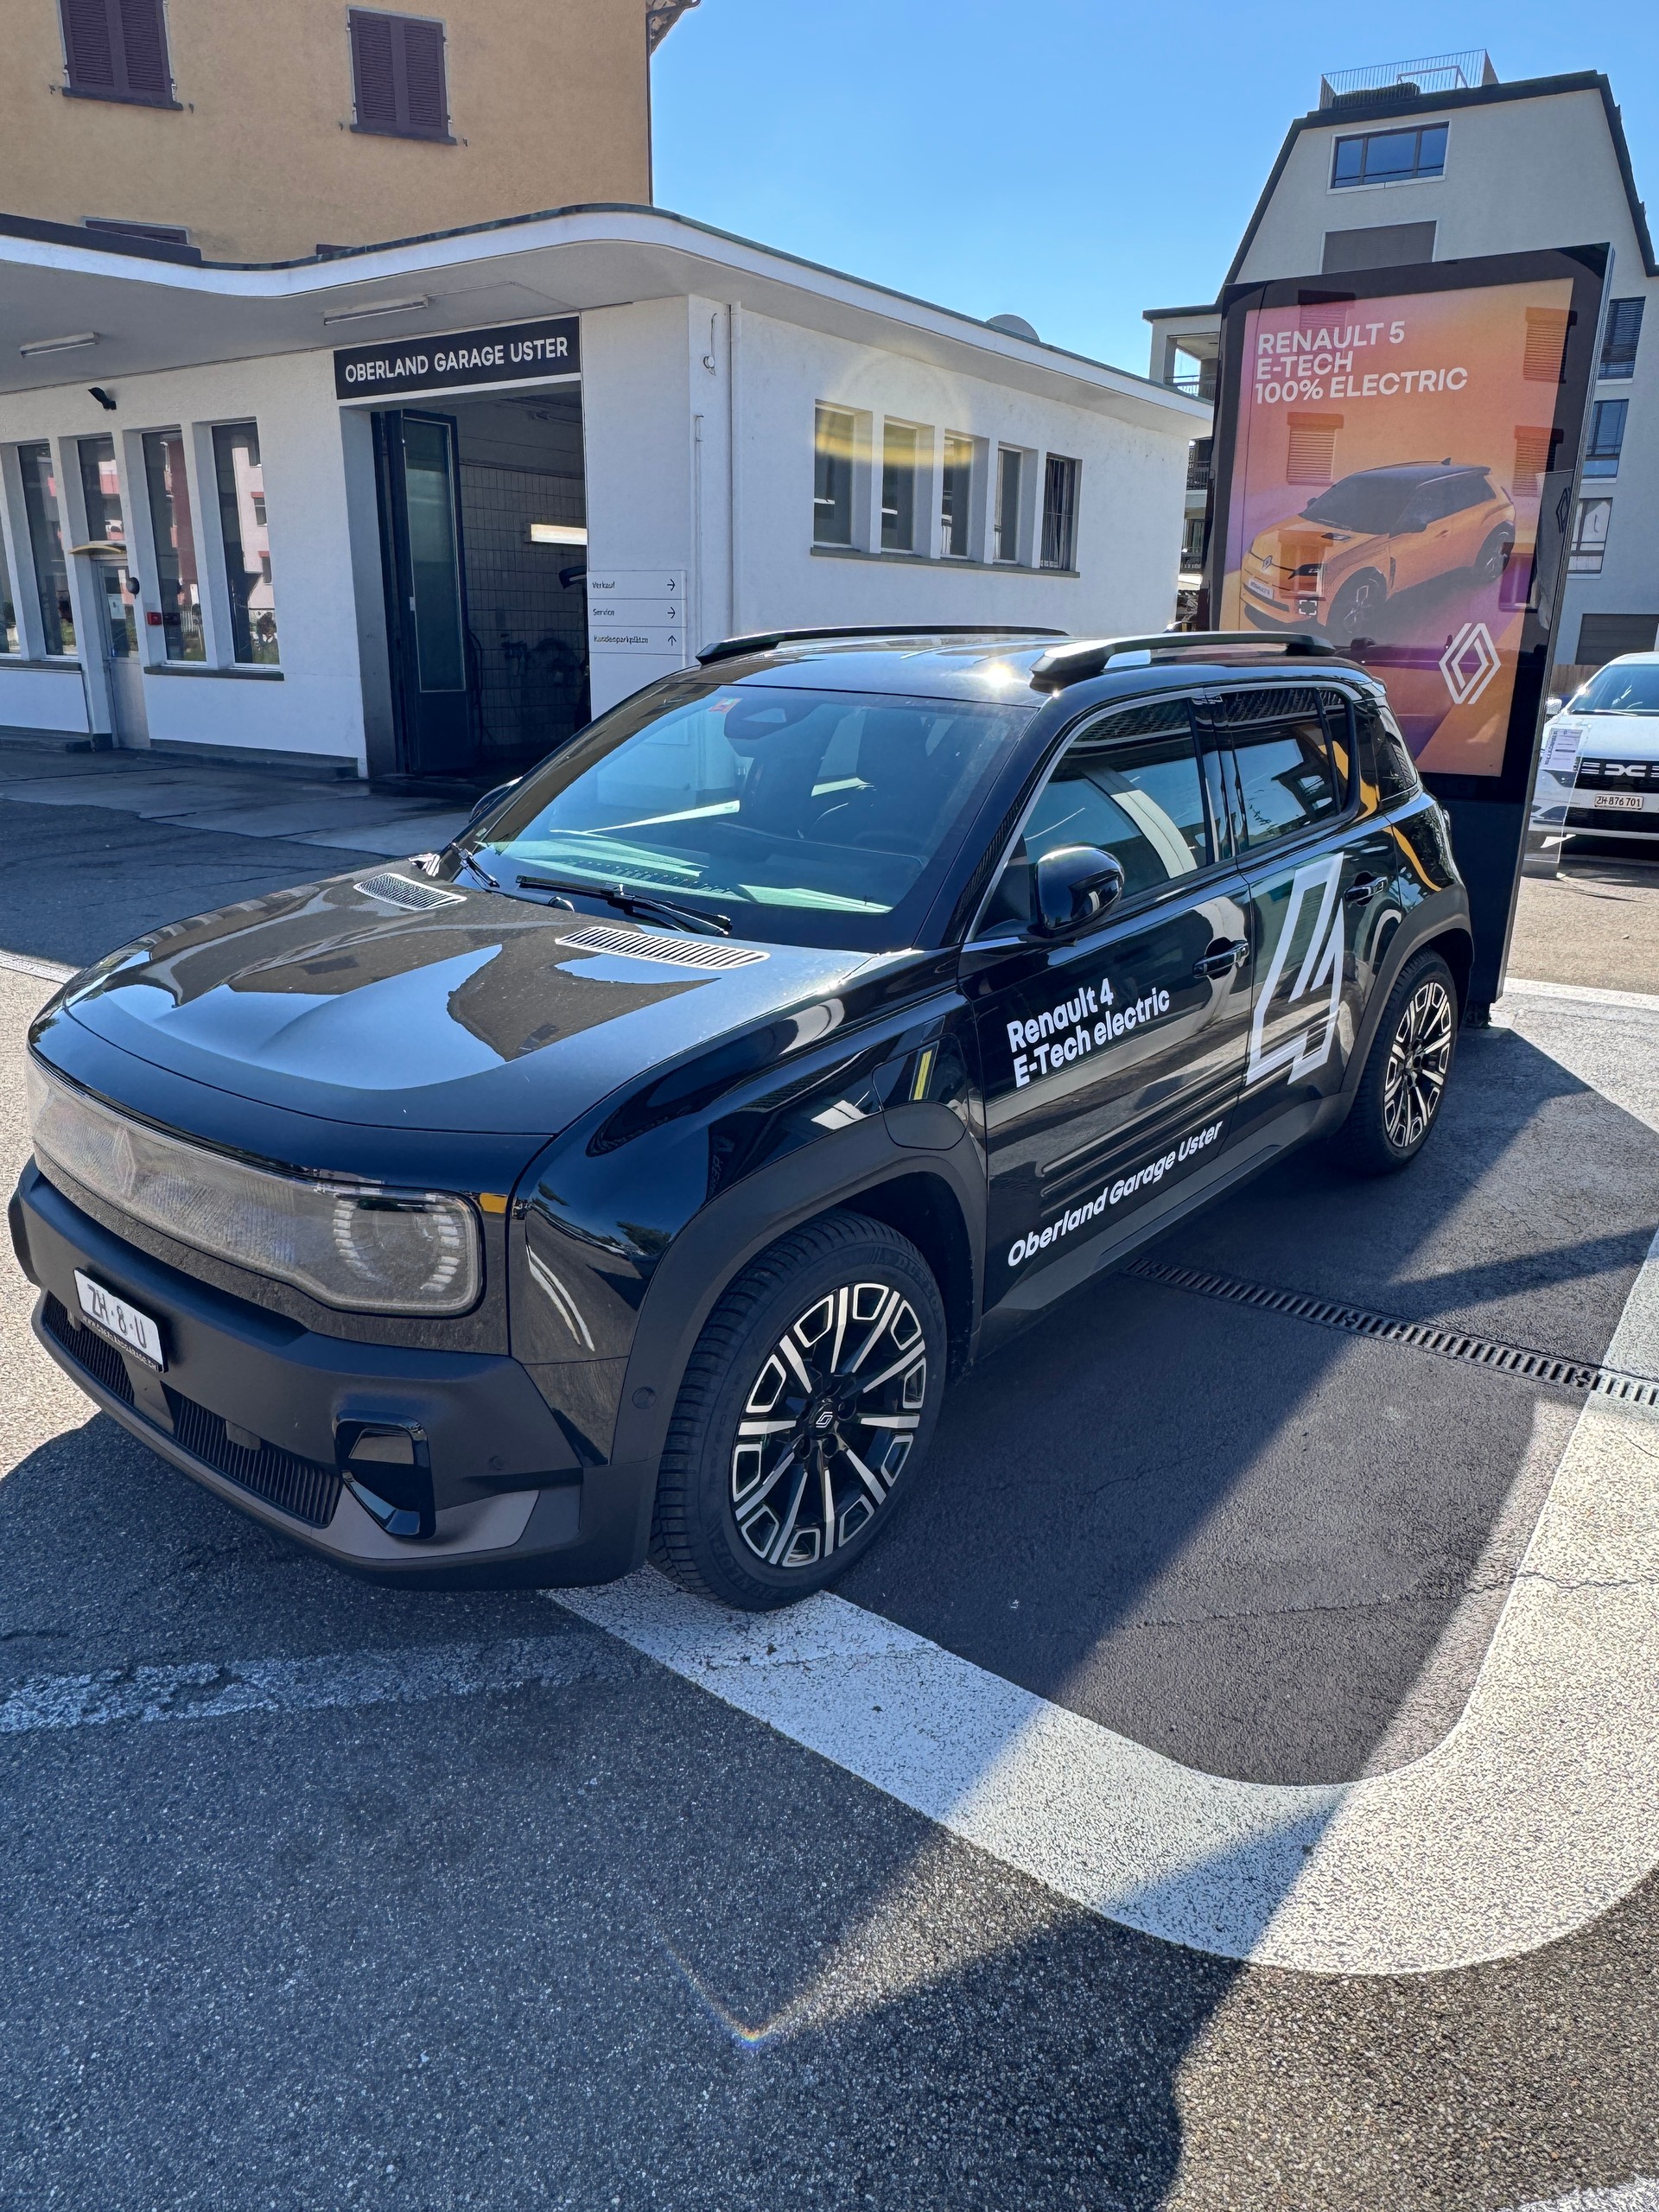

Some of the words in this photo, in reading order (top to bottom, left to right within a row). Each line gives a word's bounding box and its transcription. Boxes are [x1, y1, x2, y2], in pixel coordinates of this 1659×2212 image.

[345, 355, 429, 383] OBERLAND
[434, 345, 505, 372] GARAGE
[510, 336, 569, 363] USTER
[1257, 322, 1384, 355] RENAULT
[1389, 321, 1405, 344] 5
[1255, 378, 1324, 404] 100%
[1329, 366, 1468, 399] ELECTRIC
[1256, 351, 1353, 380] E-TECH
[1007, 986, 1099, 1052] Renault
[1100, 977, 1115, 1006] 4
[1014, 1025, 1091, 1088] E-Tech
[1094, 988, 1170, 1046] electric
[1007, 1186, 1109, 1267] Oberland
[1109, 1151, 1176, 1205] Garage
[1178, 1121, 1223, 1162] Uster
